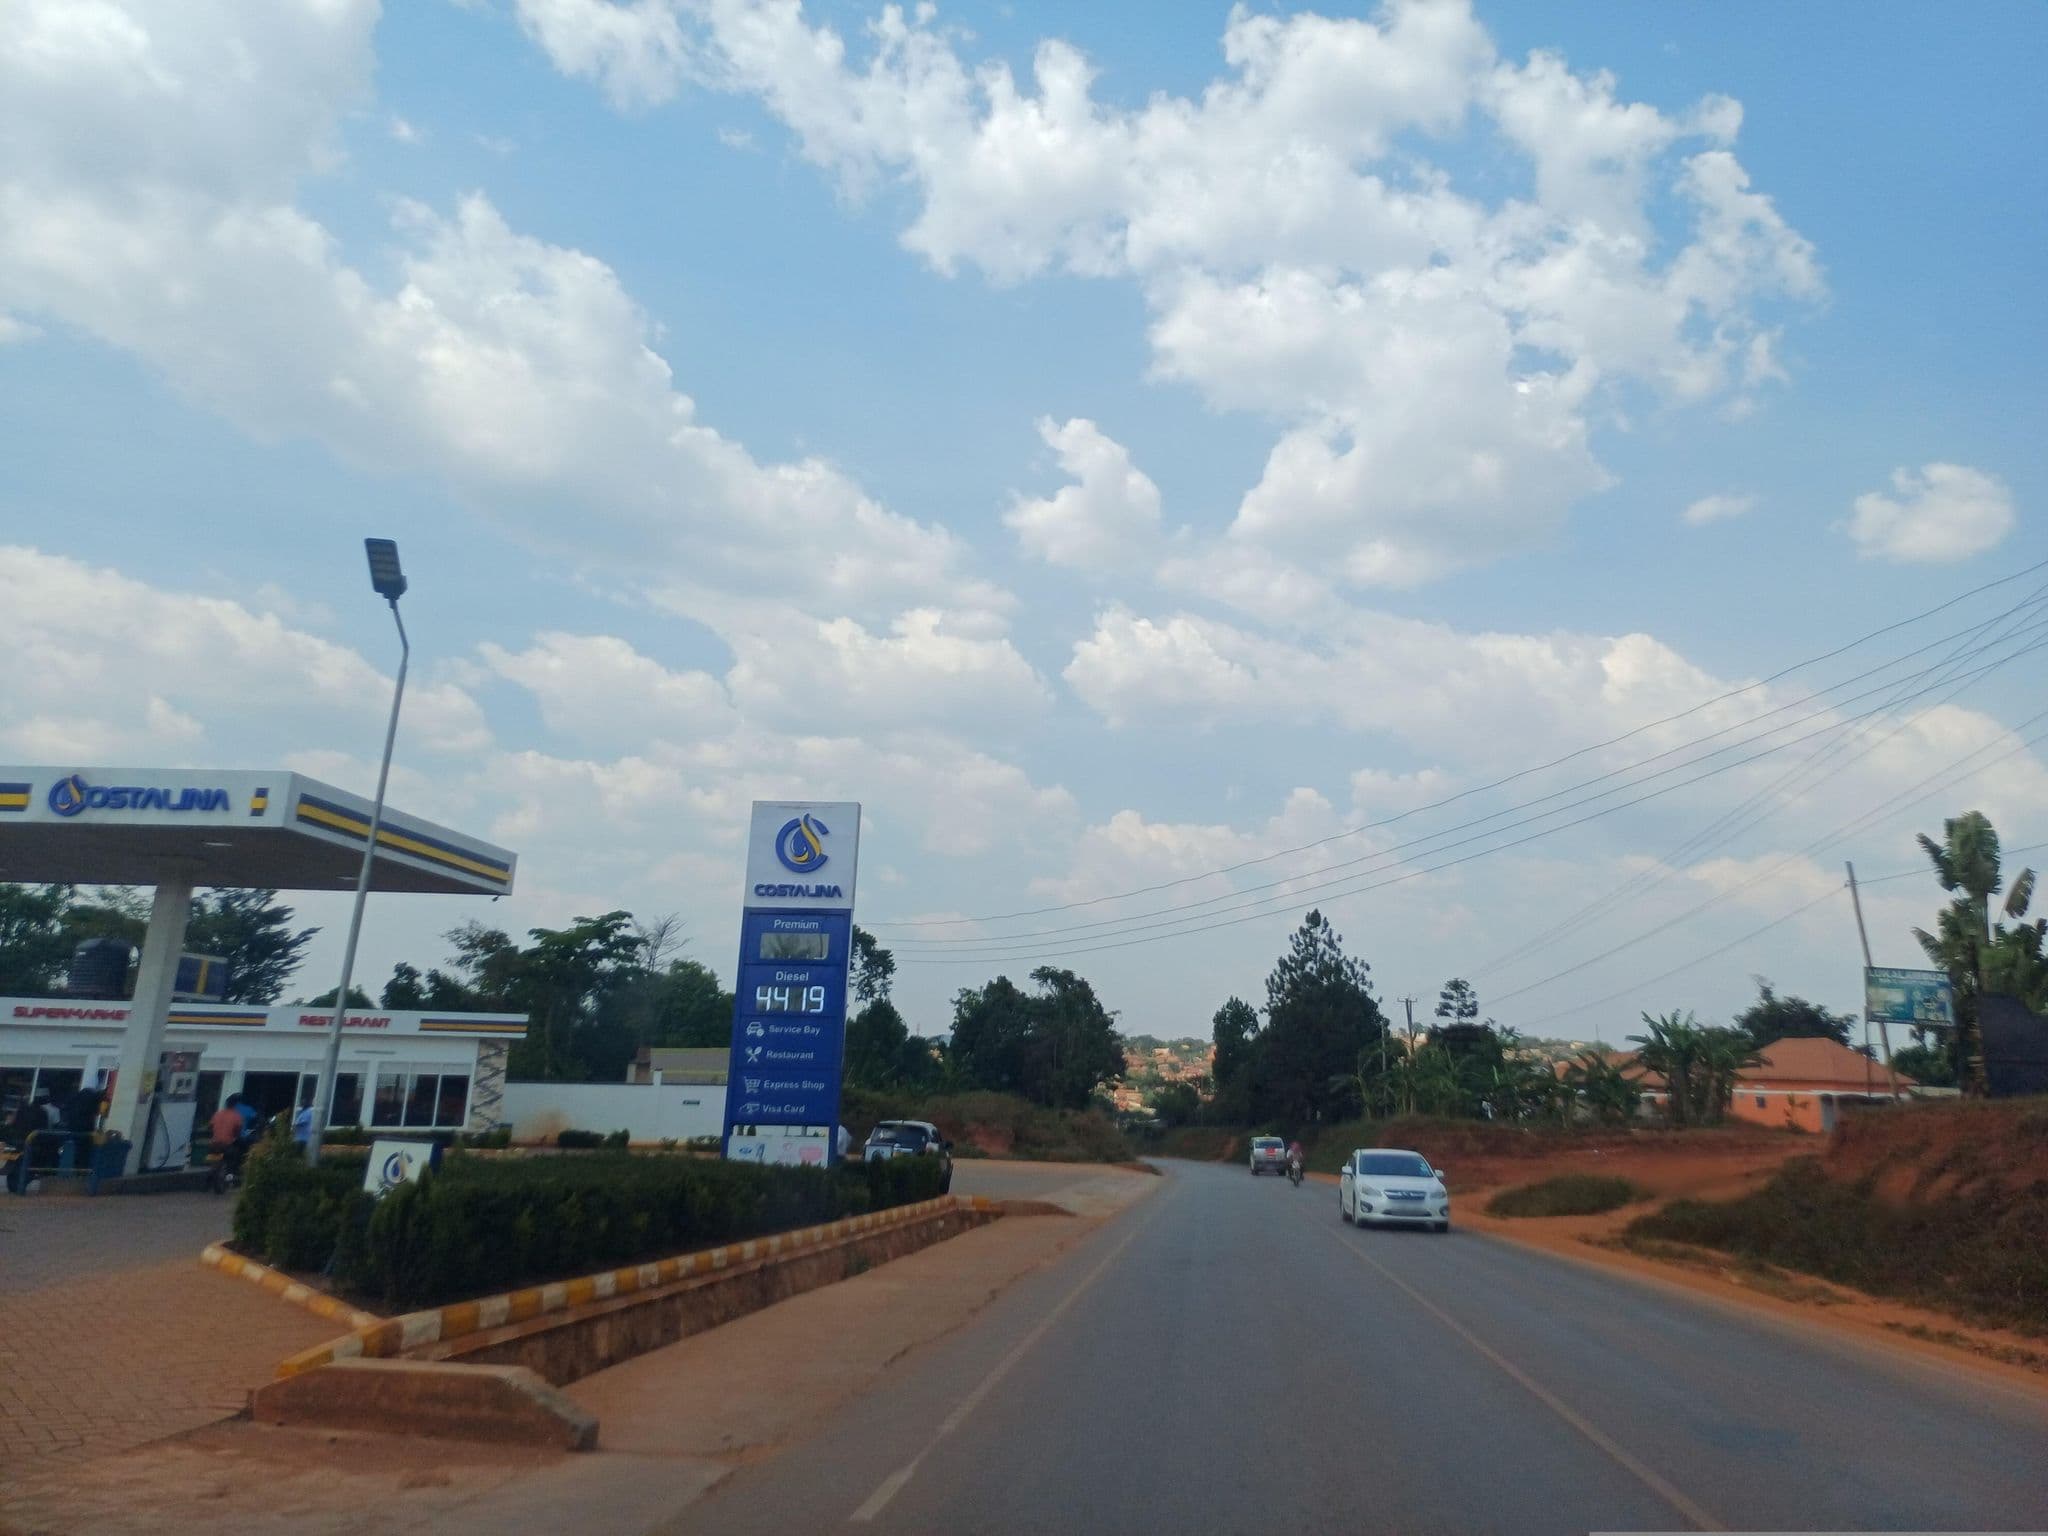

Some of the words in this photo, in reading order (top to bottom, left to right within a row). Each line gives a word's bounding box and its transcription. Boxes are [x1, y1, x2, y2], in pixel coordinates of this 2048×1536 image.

[755, 884, 842, 899] COSTALINA
[773, 919, 819, 929] Premium
[775, 971, 809, 981] Diesel
[756, 986, 825, 1013] 4419
[299, 1015, 391, 1027] RESTURANT
[769, 1024, 801, 1034] Service
[804, 1025, 821, 1035] Bay
[766, 1050, 814, 1060] Restaurant
[764, 1080, 799, 1091] Express
[802, 1080, 825, 1091] Shop
[762, 1105, 781, 1113] Visa
[784, 1104, 805, 1113] Card
